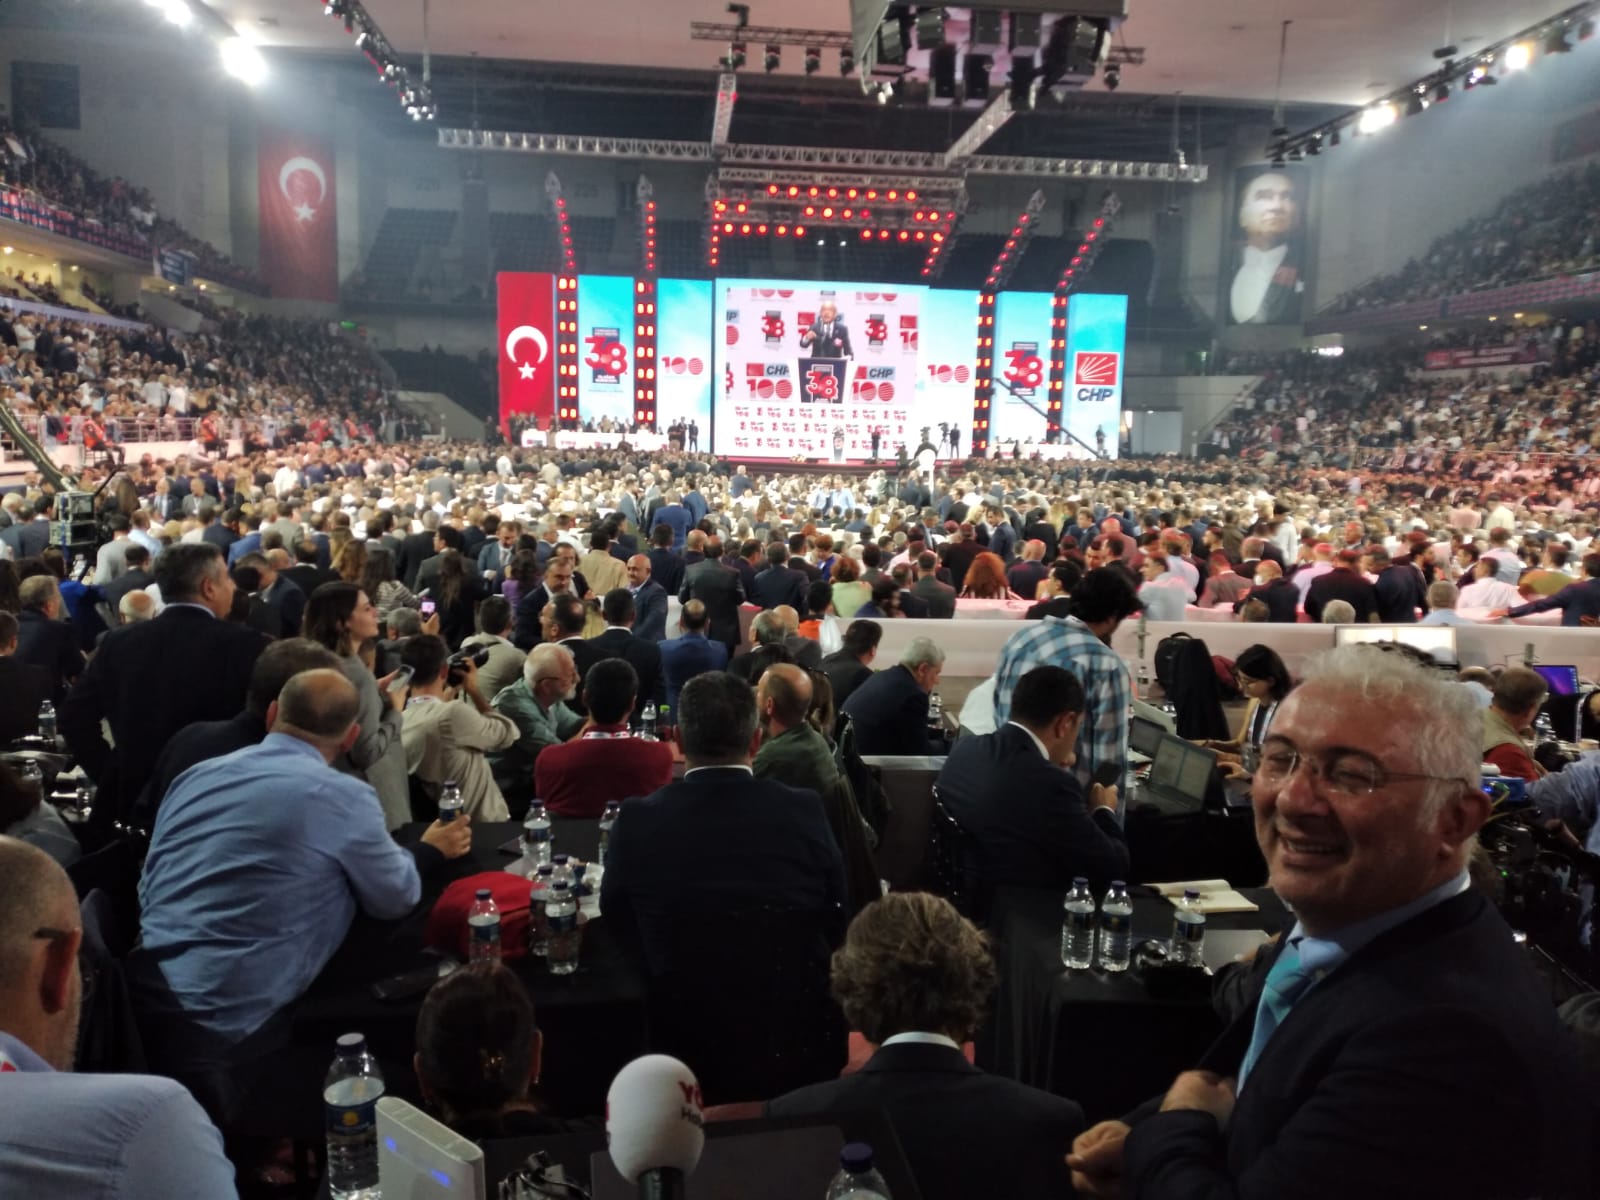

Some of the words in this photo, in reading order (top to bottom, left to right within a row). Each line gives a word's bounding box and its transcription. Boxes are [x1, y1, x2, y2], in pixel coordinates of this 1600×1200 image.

[761, 316, 785, 338] 38
[866, 319, 888, 341] 38
[584, 336, 628, 376] 38
[662, 356, 704, 375] 100
[869, 368, 893, 379] CHP
[928, 364, 970, 384] 100
[1004, 350, 1044, 388] 38
[746, 379, 792, 399] 100
[806, 372, 838, 399] 38
[852, 382, 895, 402] 100
[1077, 388, 1113, 401] CHP
